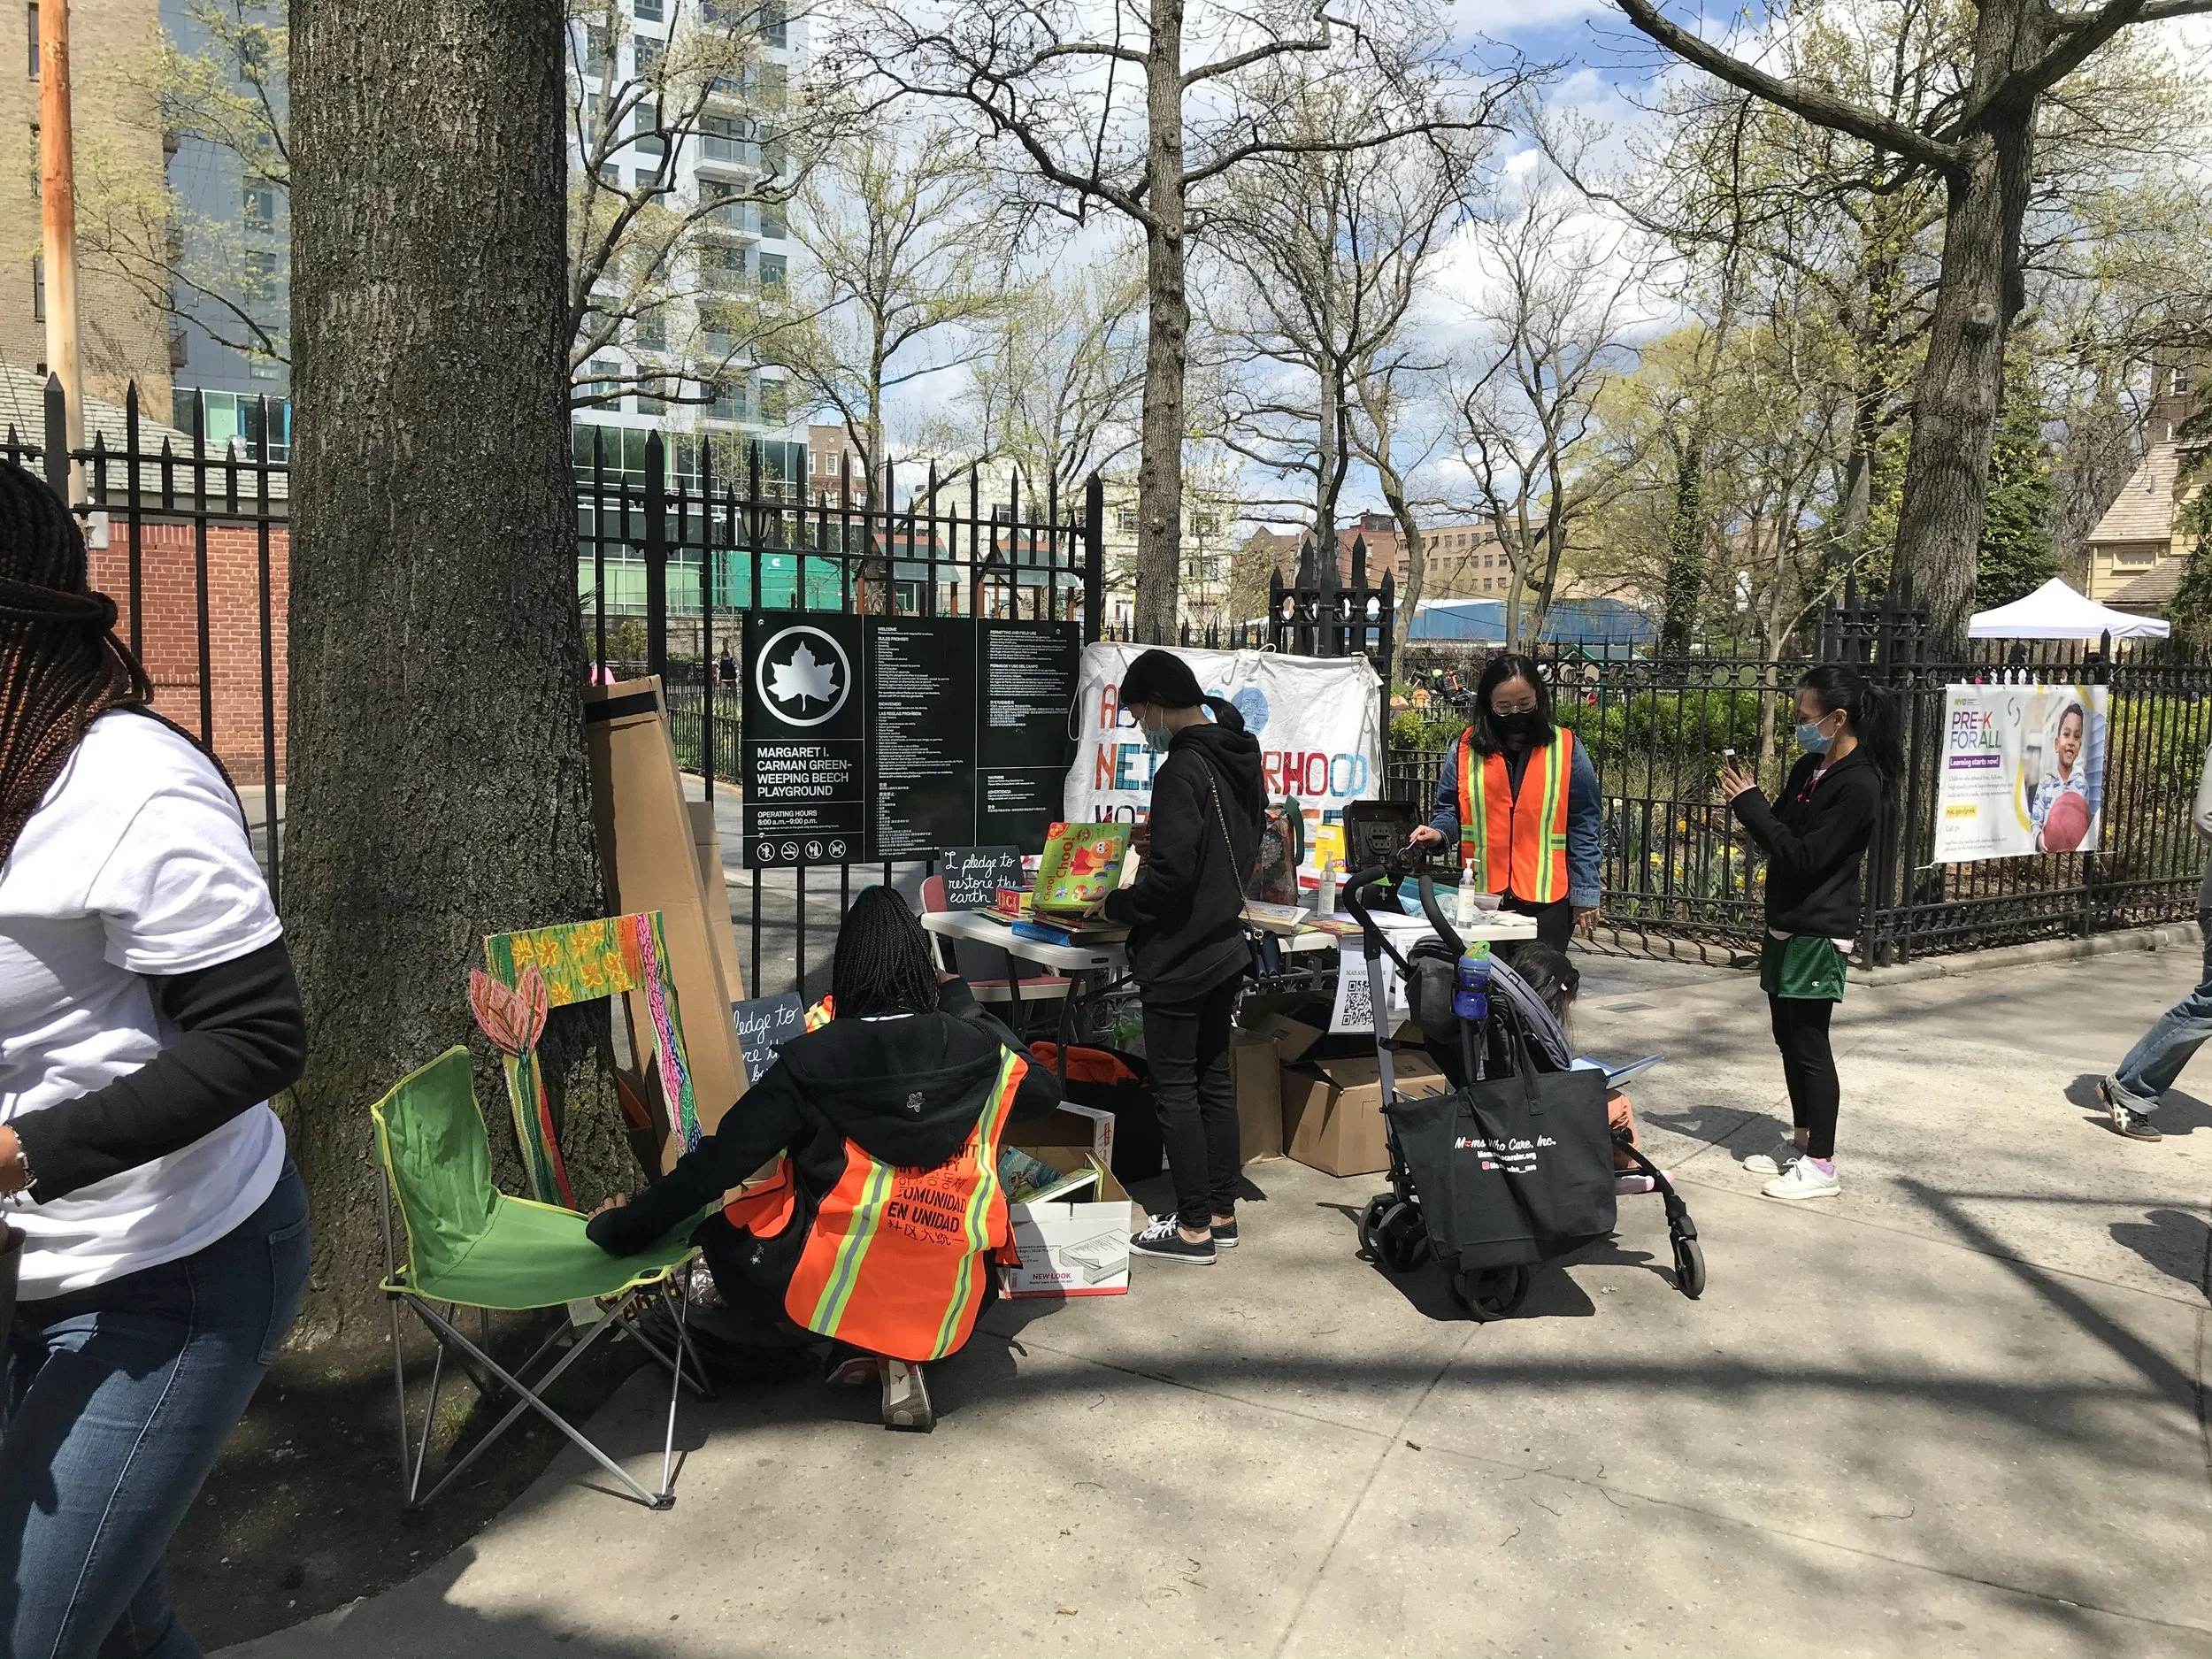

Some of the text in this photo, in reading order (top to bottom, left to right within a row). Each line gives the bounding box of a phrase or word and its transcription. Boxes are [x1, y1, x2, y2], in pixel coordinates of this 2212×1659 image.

[1952, 711, 1993, 729] PRE-K
[1950, 730, 2001, 749] FOR ALL
[757, 747, 829, 758] MARGARET I.
[757, 760, 853, 771] CARMAN GREEN-
[1950, 758, 1971, 767] Learning
[757, 772, 849, 784] WEEPING BEECH
[758, 785, 833, 797] PLAYGROUND
[945, 851, 959, 869] I
[962, 853, 997, 878] pledge
[999, 852, 1015, 867] to
[1044, 837, 1075, 901] Choo! Choo!
[948, 874, 1016, 890] restore the
[733, 1004, 799, 1044] ledge to
[1488, 1138, 1506, 1151] Who
[1537, 1135, 1557, 1147] Inc.
[887, 1201, 960, 1233] EN UNIDAD
